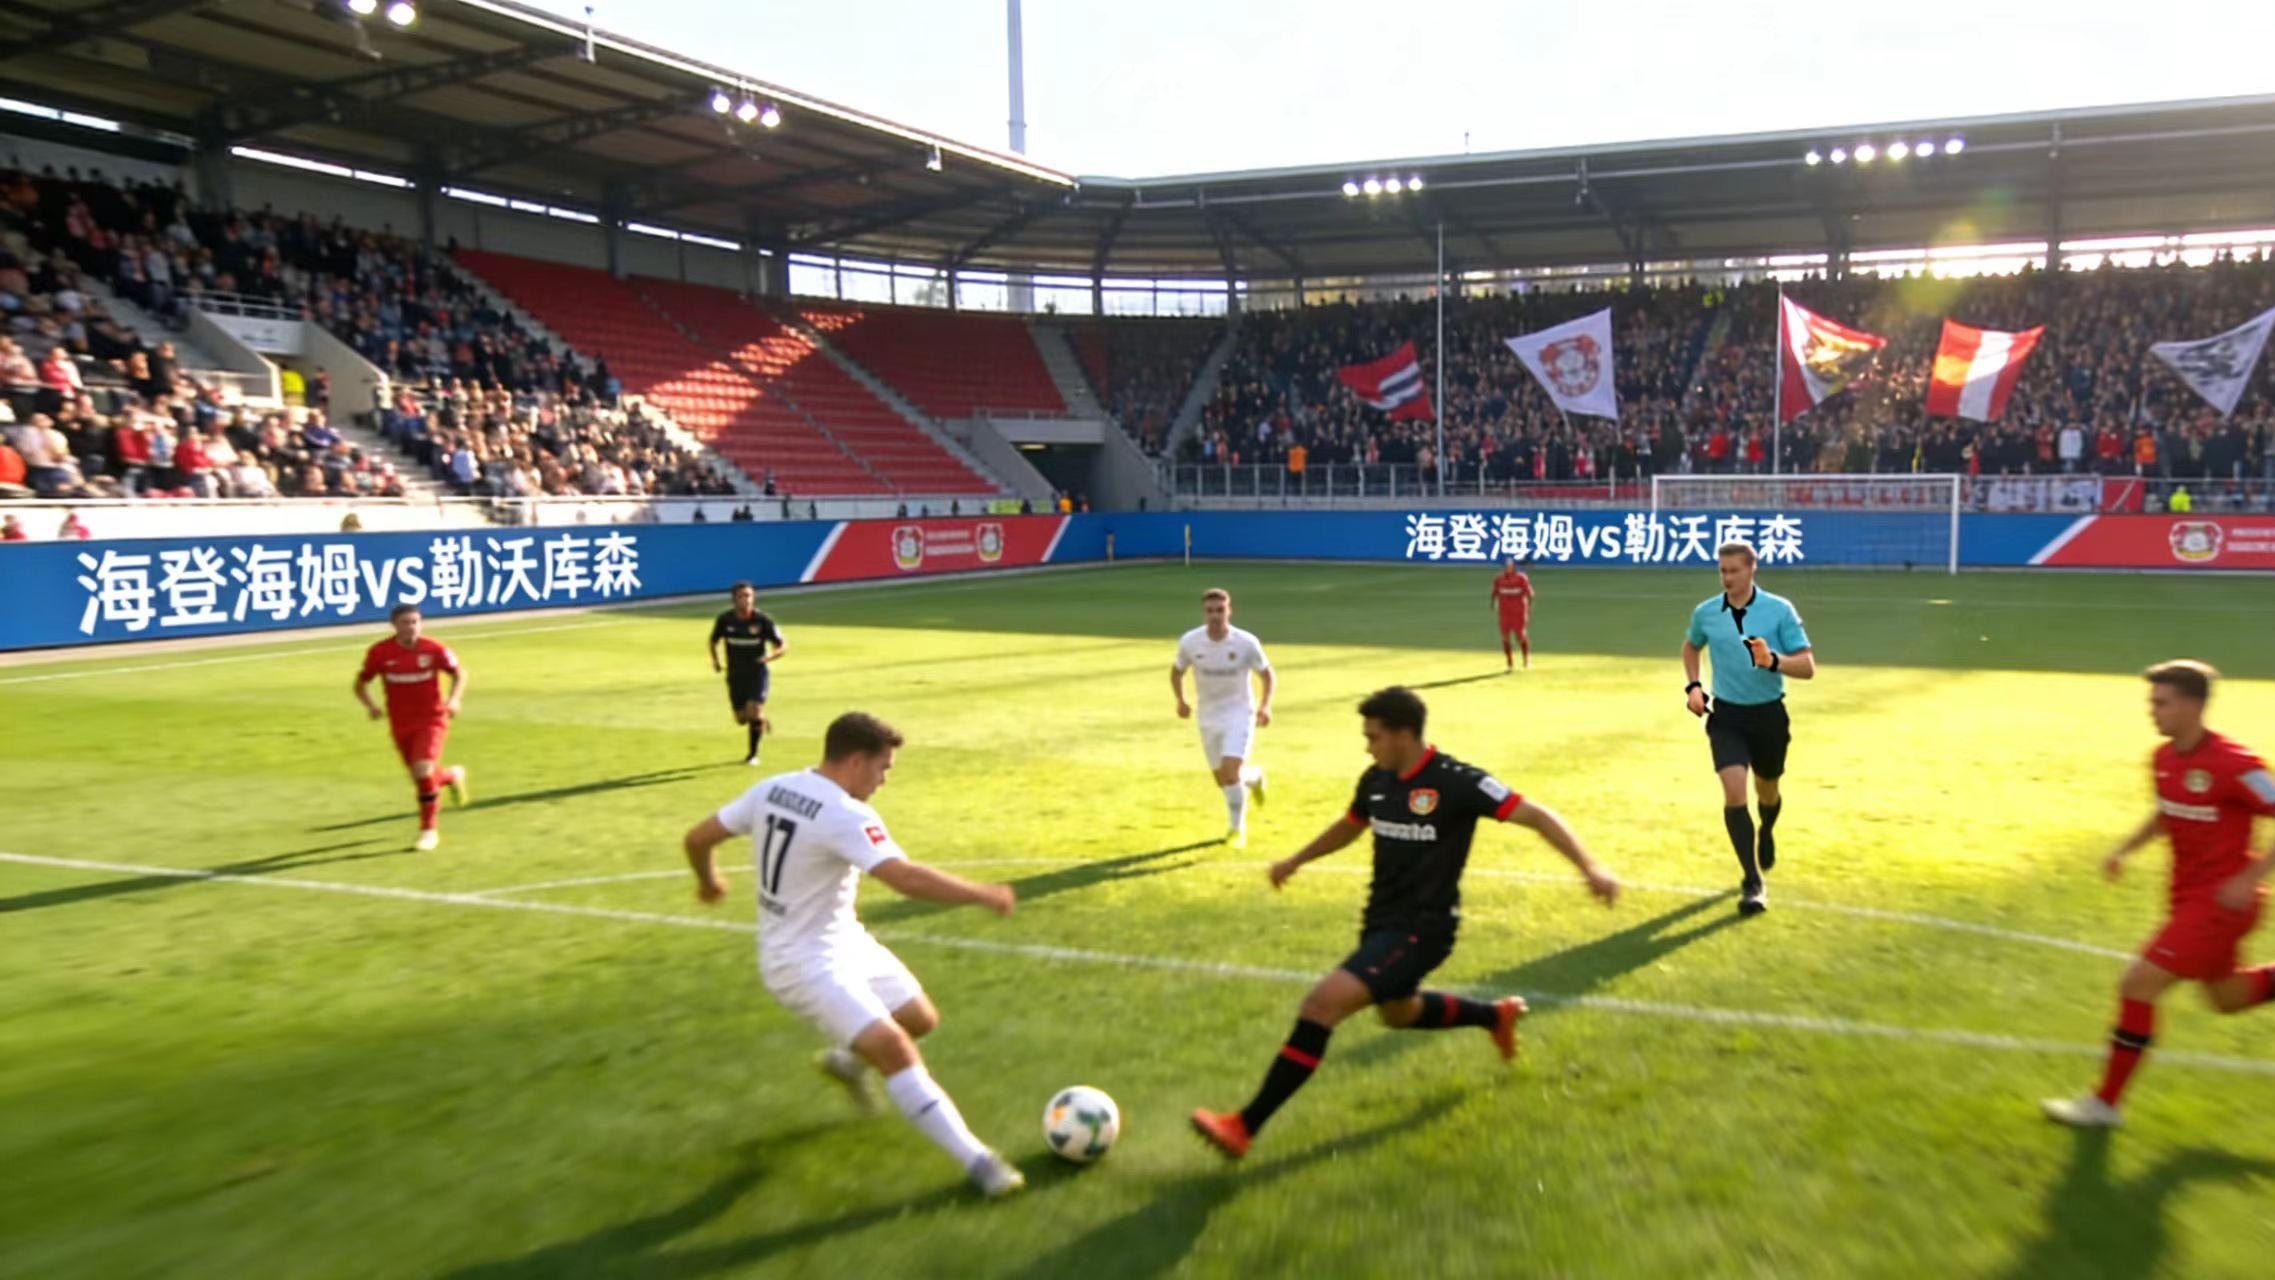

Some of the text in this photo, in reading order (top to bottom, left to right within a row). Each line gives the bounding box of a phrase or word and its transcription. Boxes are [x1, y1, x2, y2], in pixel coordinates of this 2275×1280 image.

[77, 531, 642, 636] 海登海姆vs勒沃库森
[761, 813, 797, 896] 17
